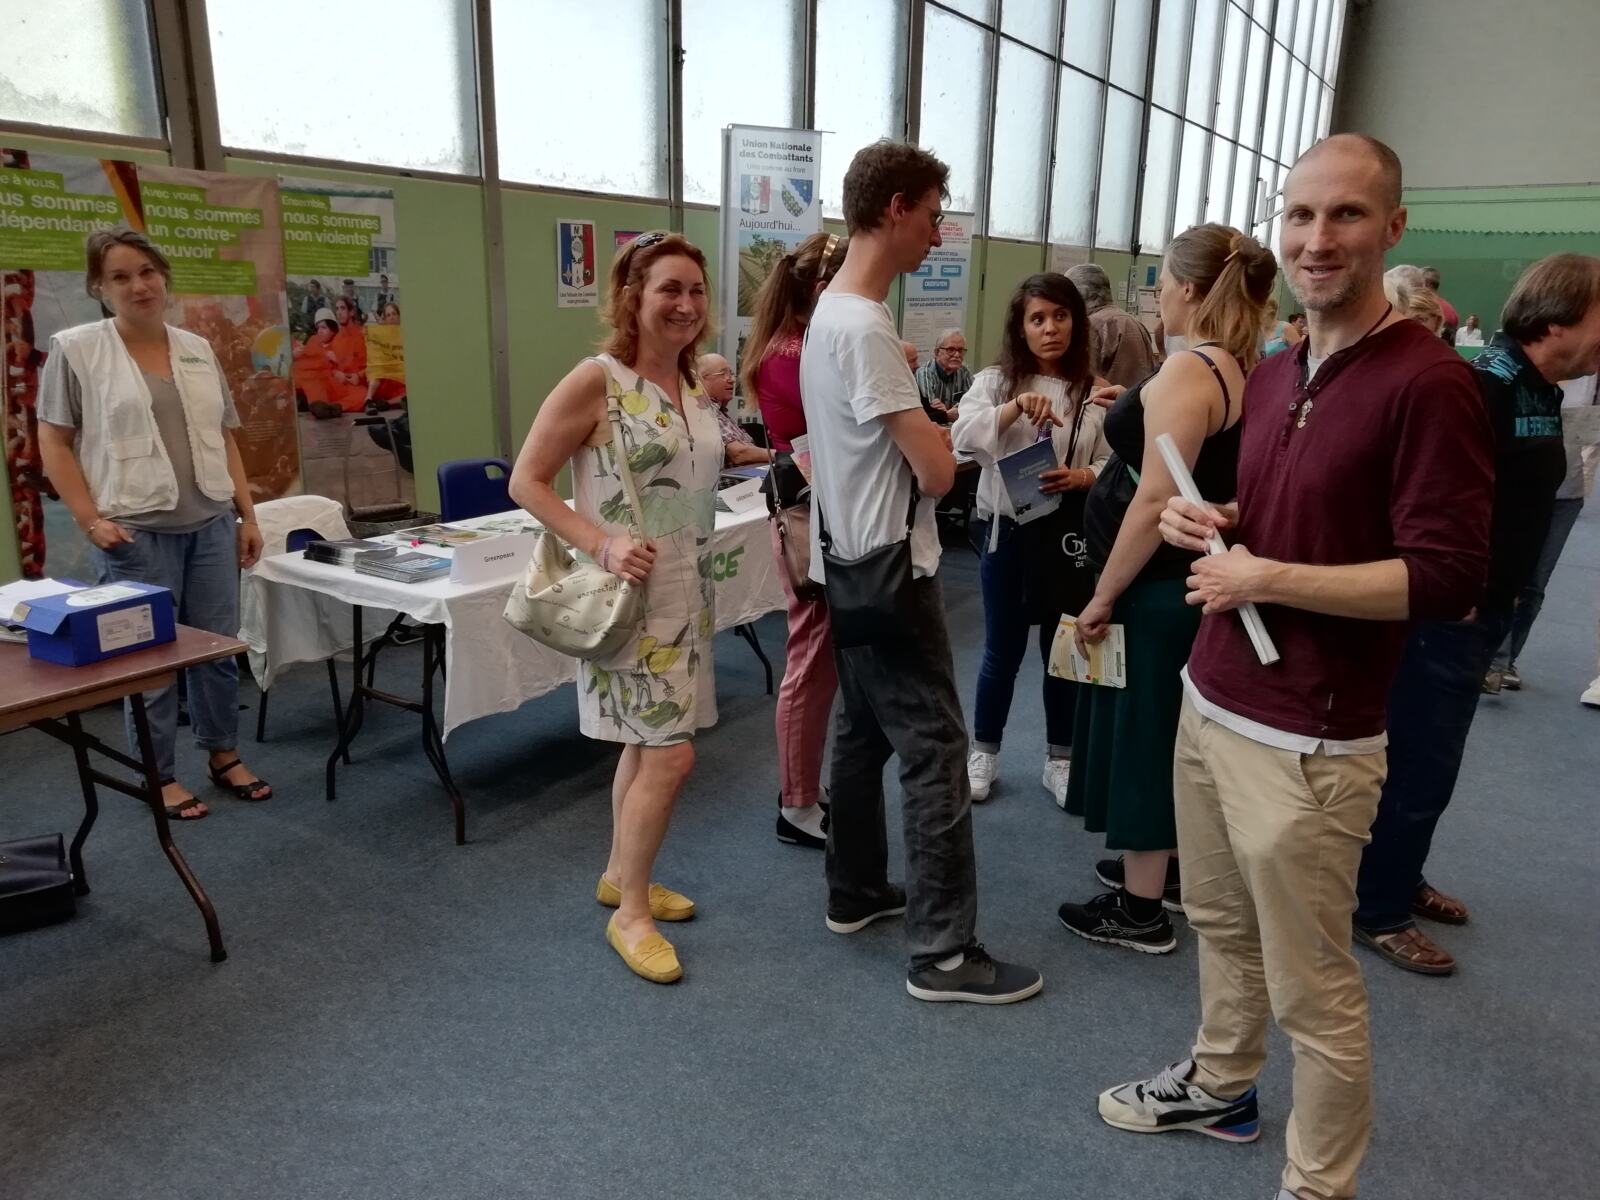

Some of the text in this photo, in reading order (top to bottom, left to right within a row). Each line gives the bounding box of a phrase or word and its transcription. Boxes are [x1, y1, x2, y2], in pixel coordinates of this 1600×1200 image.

[742, 139, 812, 152] Union Nationale
[740, 150, 814, 163] des Combattants
[24, 177, 60, 190] vous,
[142, 185, 203, 203] Avec vous,
[31, 194, 118, 214] sommes
[144, 204, 260, 224] nous sommes
[283, 211, 380, 231] nous sommes
[147, 223, 237, 242] un contre-
[284, 228, 369, 247] non violents
[483, 551, 515, 563] Greenpeace
